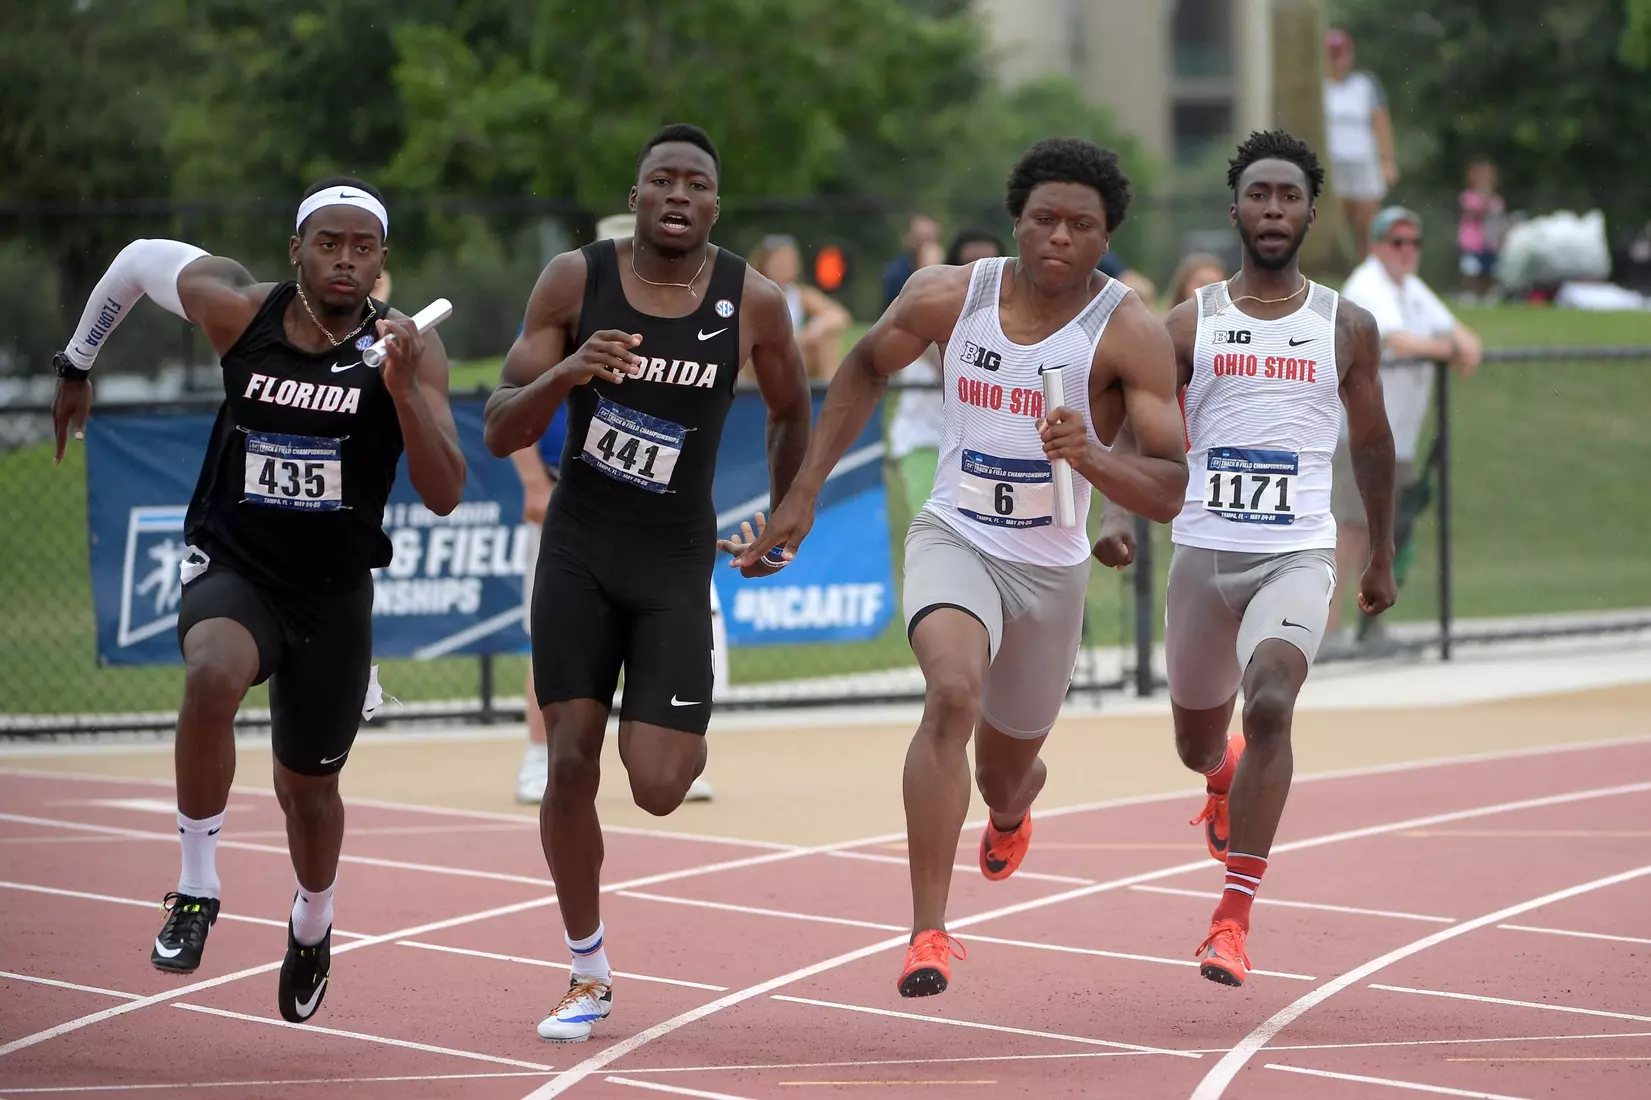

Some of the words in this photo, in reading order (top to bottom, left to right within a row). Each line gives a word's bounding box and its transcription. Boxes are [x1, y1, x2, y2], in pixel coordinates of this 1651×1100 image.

[85, 297, 121, 347] FLORIDA
[715, 300, 734, 317] SEC
[612, 356, 718, 388] ORIDA
[1213, 353, 1258, 377] OHIO
[1264, 356, 1317, 383] STATE
[242, 372, 361, 414] FLORIDA
[958, 376, 1003, 411] OHIO
[1009, 387, 1044, 418] STA
[597, 428, 660, 479] 441
[258, 458, 326, 498] 435
[1207, 473, 1291, 512] 1171
[994, 482, 1014, 516] 6
[734, 582, 885, 630] #NCAATF
